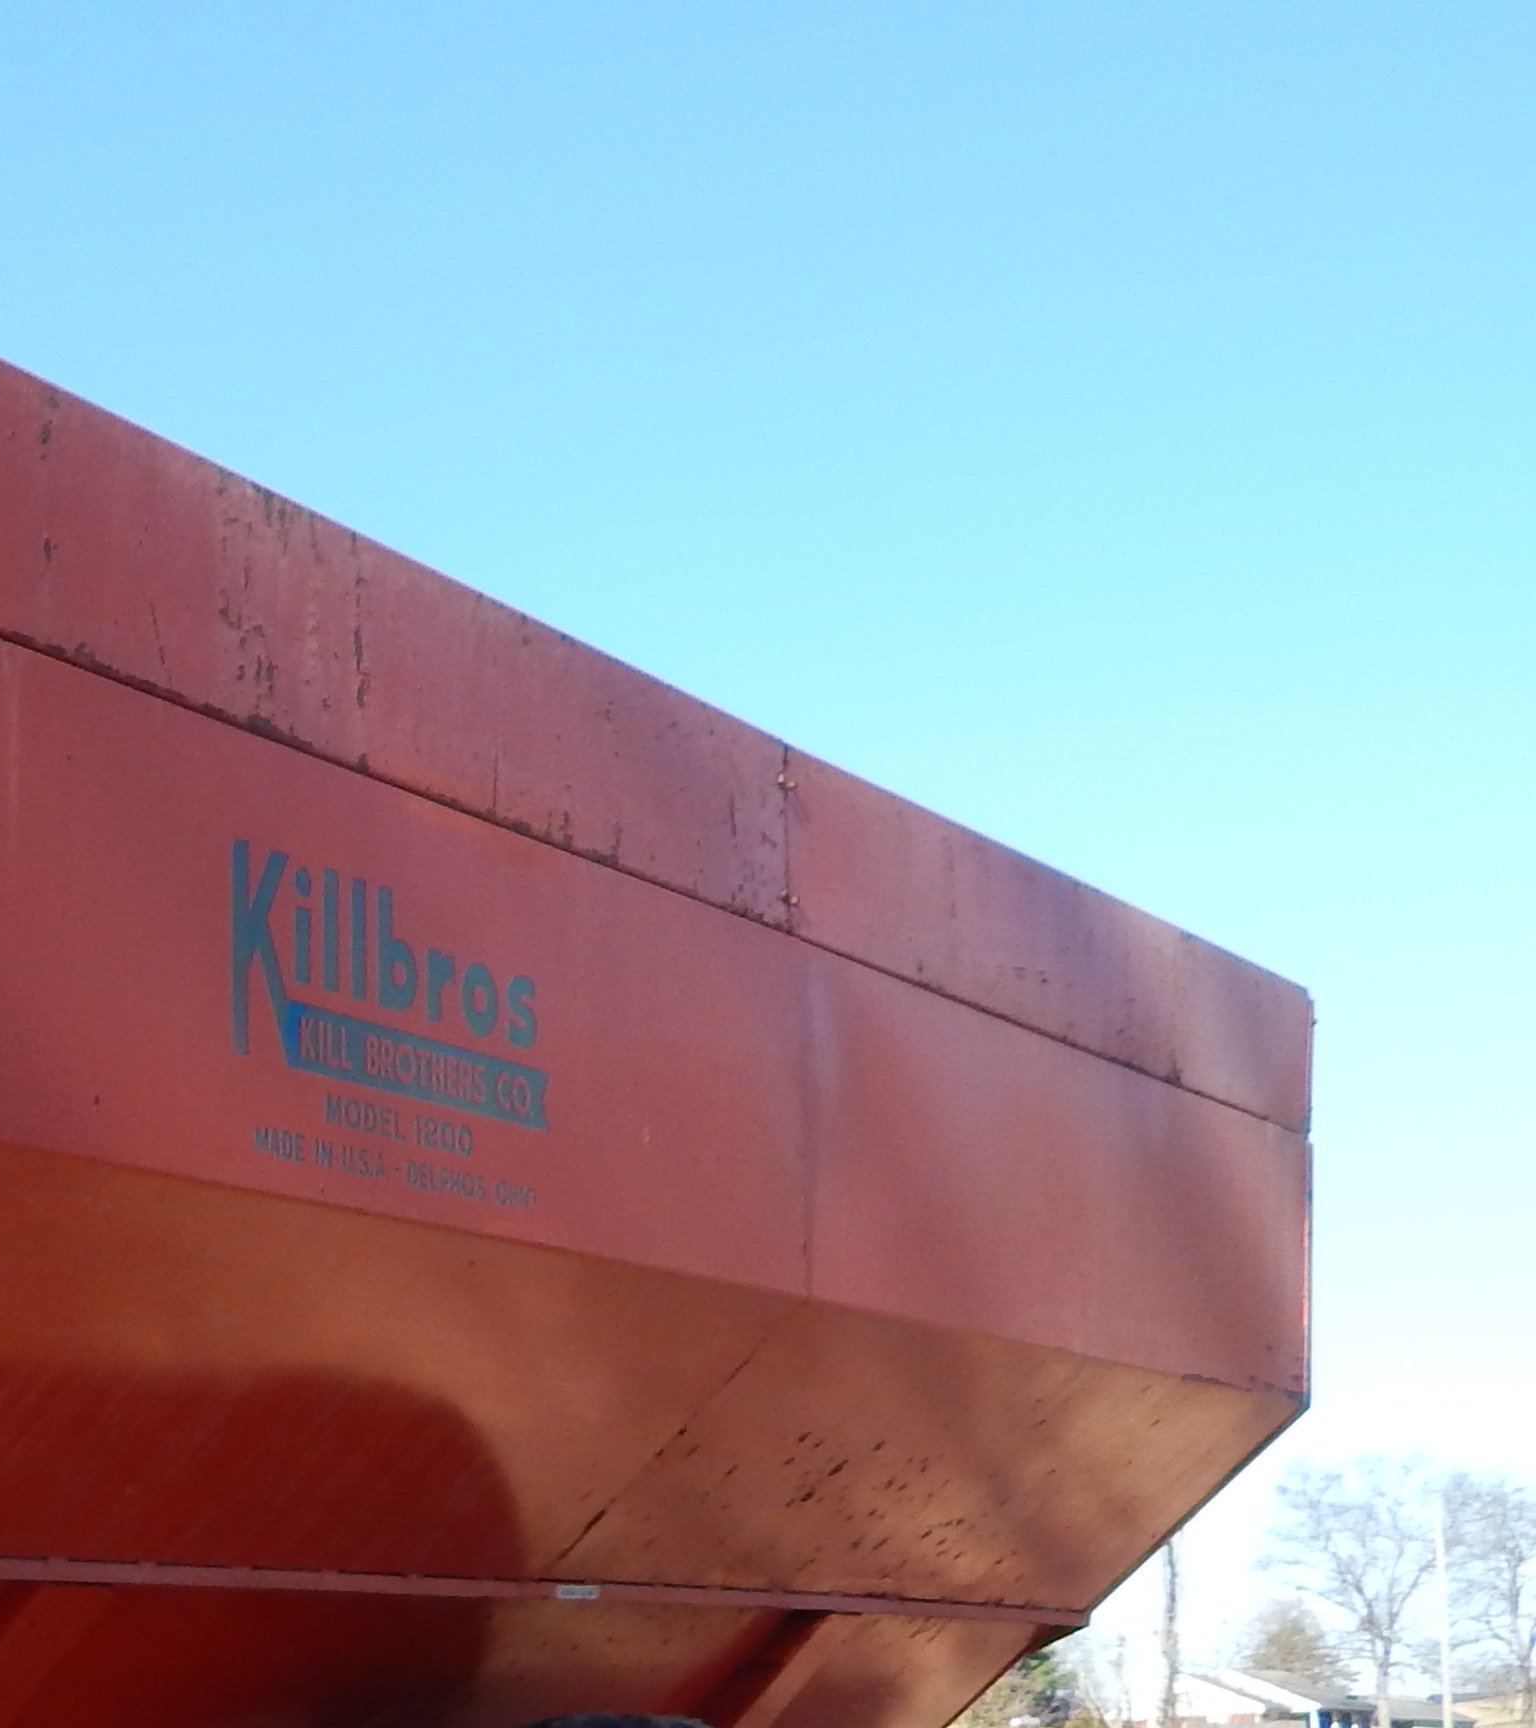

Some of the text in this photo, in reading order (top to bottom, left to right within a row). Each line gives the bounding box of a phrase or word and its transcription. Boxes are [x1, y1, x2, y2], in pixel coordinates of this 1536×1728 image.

[232, 838, 538, 1056] Killbros
[300, 1015, 352, 1071] KILL
[364, 1033, 487, 1104] BROTHERS
[254, 1127, 305, 1164] MADE
[314, 1138, 333, 1168] IN
[324, 1094, 473, 1157] MODEL 1200
